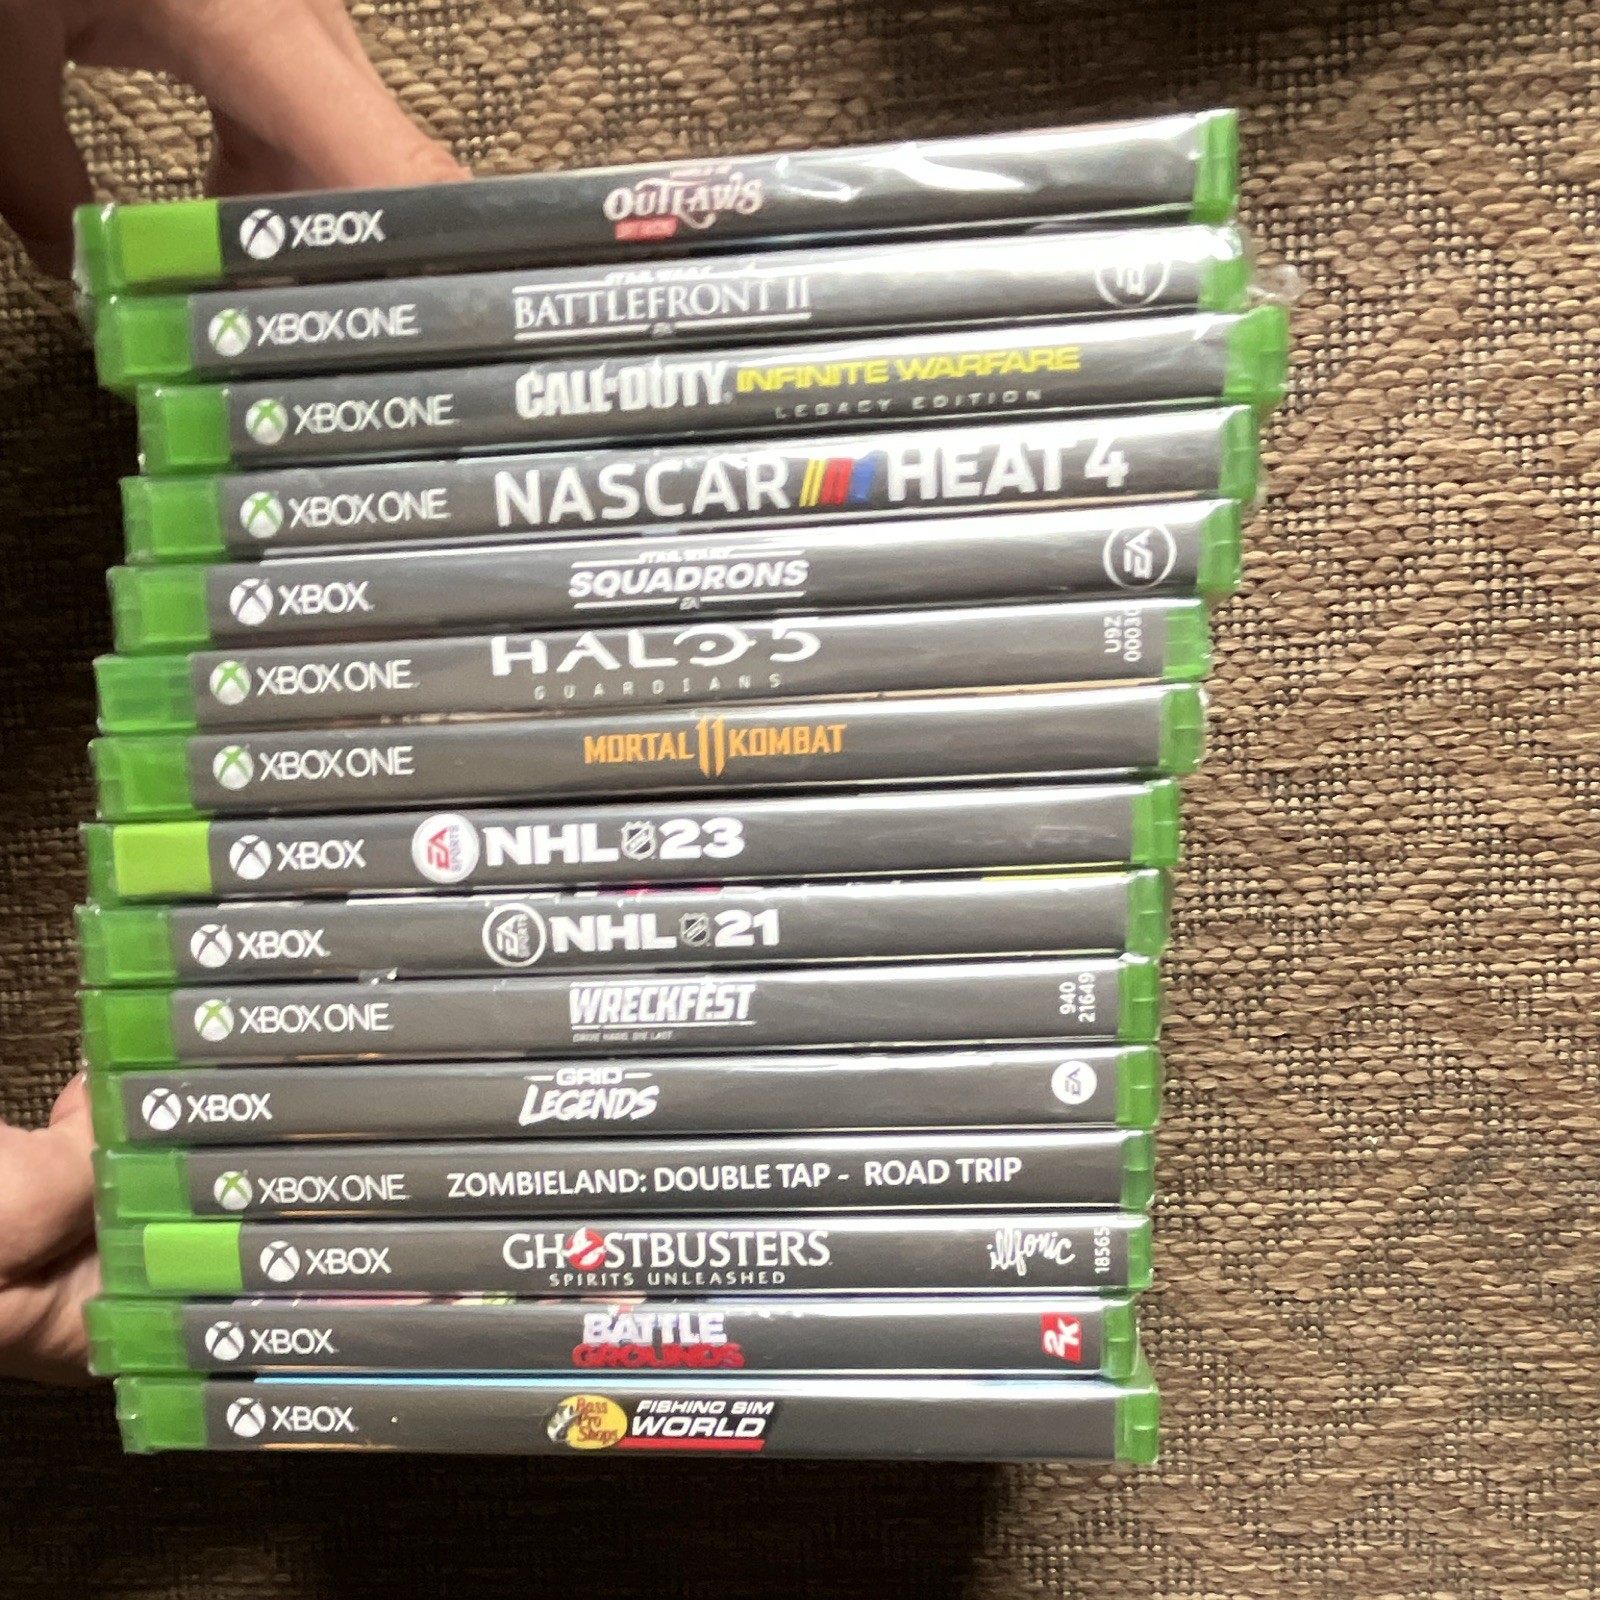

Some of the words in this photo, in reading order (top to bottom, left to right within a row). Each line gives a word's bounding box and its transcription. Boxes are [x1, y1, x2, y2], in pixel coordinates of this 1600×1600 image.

[290, 209, 387, 249] XBOX
[513, 279, 777, 330] BATTLEFRONT
[786, 276, 812, 309] II
[256, 309, 345, 347] XBOX
[346, 303, 421, 339] ONE
[736, 358, 890, 393] INFINITE
[895, 345, 1081, 382] WARFARE
[515, 363, 613, 419] CALL
[618, 357, 729, 410] DUTY
[775, 398, 894, 419] LEGACY
[911, 388, 1043, 411] EDITION
[293, 399, 382, 435] XBOX
[383, 393, 458, 429] ONE
[494, 456, 792, 527] NASCAR
[887, 437, 1079, 503] HEAT
[1083, 436, 1130, 488] 4
[288, 493, 377, 529] XBOX
[378, 488, 450, 524] ONE
[568, 560, 810, 598] SQUADRONS
[278, 581, 371, 616] XBOX
[491, 625, 757, 677] HALO
[256, 663, 342, 696] XBOX
[344, 659, 413, 692] ONE
[532, 672, 784, 701] GUARDIANS
[584, 731, 695, 764] MORTAL
[728, 723, 848, 757] KOMBAT
[259, 749, 344, 782] XBOX
[346, 746, 416, 777] ONE
[276, 838, 367, 871] XBOX
[481, 823, 619, 866] NHL
[659, 817, 746, 860] 23
[236, 928, 325, 960] XBOX
[549, 913, 677, 953] NHL
[714, 909, 780, 948] 21
[569, 984, 757, 1025] WRECKFEST
[1058, 981, 1076, 1015] 940
[1077, 972, 1096, 1023] 21649
[238, 1004, 321, 1033] XBOX
[323, 1002, 390, 1032] ONE
[556, 1066, 625, 1086] GRID
[186, 1092, 272, 1123] XBOX
[518, 1083, 660, 1126] LEGENDS
[258, 1175, 340, 1204] XBOX
[341, 1173, 407, 1201] ONE
[446, 1167, 647, 1198] ZOMBIELAND:
[653, 1164, 771, 1192] DOUBLE
[775, 1163, 831, 1189] TAP
[864, 1159, 950, 1186] ROAD
[955, 1156, 1022, 1184] TRIP
[305, 1246, 392, 1275] XBOX
[549, 1272, 635, 1287] SPIRITS
[647, 1270, 786, 1286] UNLEASHED
[250, 1328, 335, 1354] XBOX
[582, 1311, 728, 1344] BATTLE
[572, 1341, 746, 1368] GROUNDS
[270, 1405, 355, 1432] XBOX
[636, 1400, 727, 1415] FISHING
[730, 1401, 775, 1415] SIM
[631, 1415, 767, 1438] WORLD
